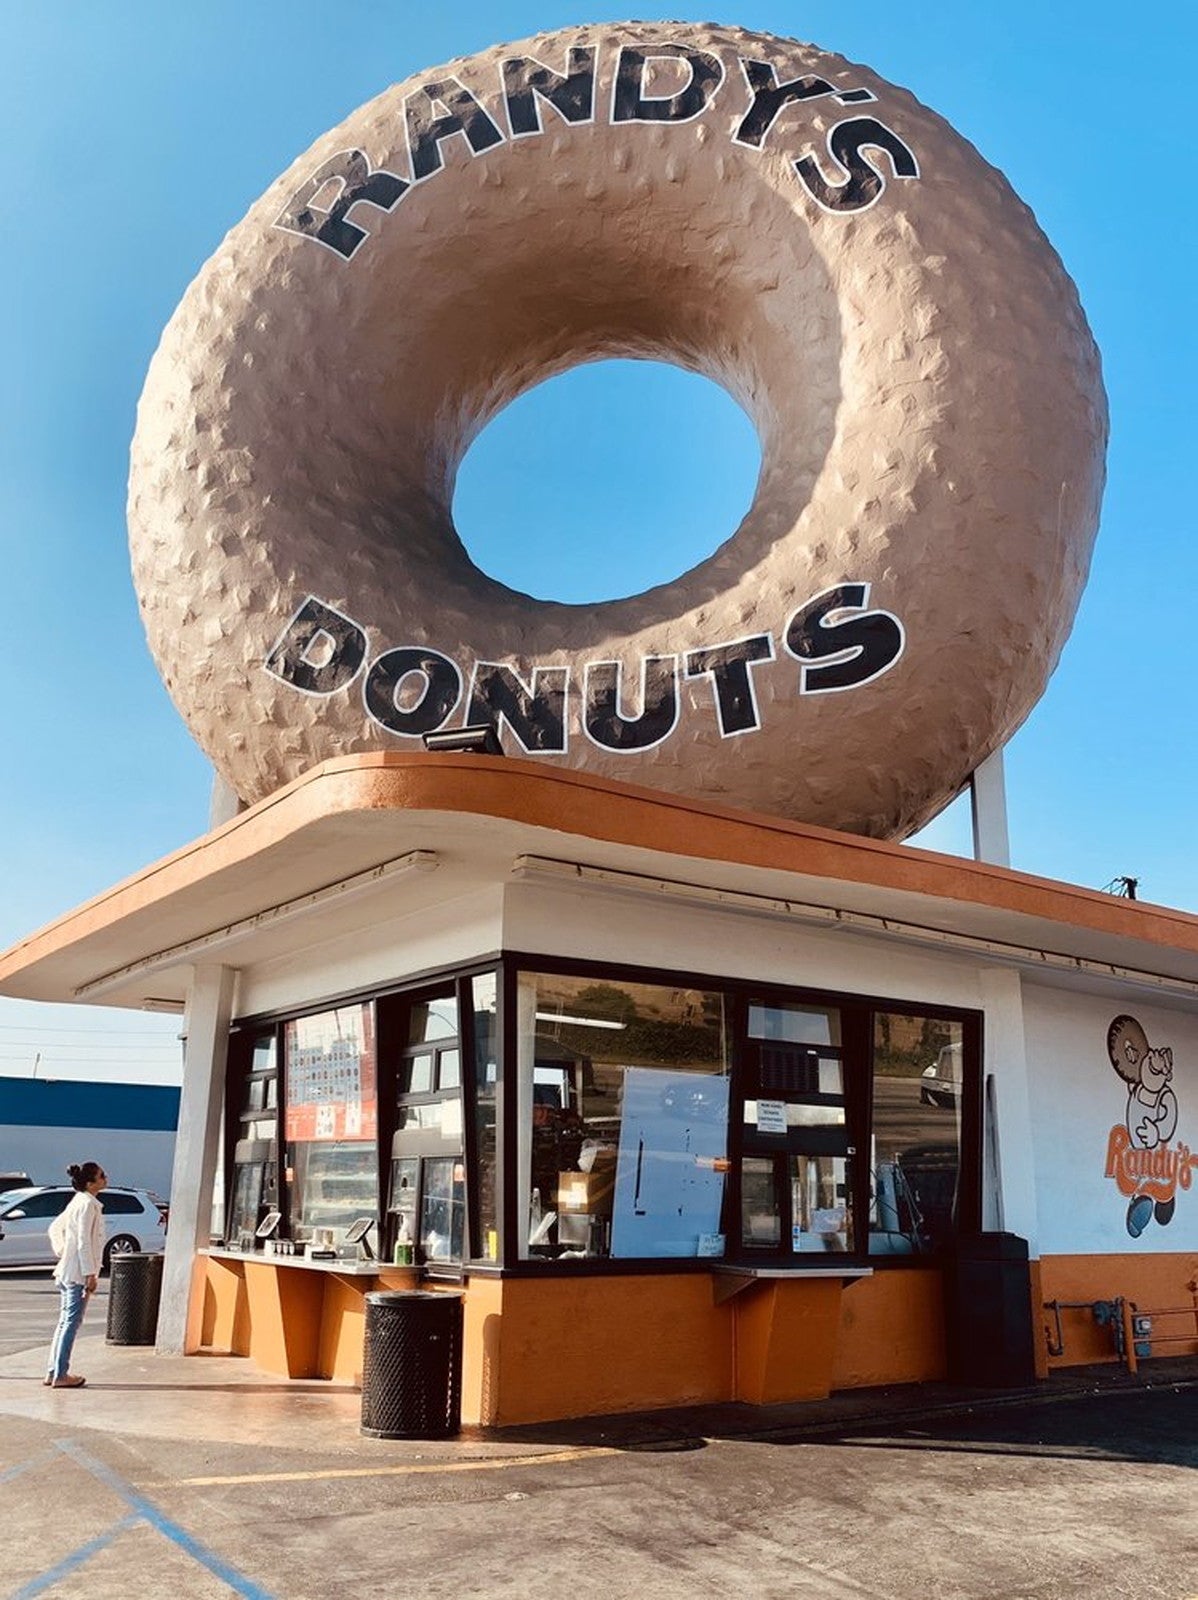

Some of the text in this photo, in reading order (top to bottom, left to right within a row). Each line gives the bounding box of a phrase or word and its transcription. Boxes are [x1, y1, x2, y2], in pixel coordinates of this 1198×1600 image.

[274, 43, 920, 260] RANDY'S
[265, 582, 906, 755] DONUTS
[1105, 1124, 1198, 1203] Randy's
